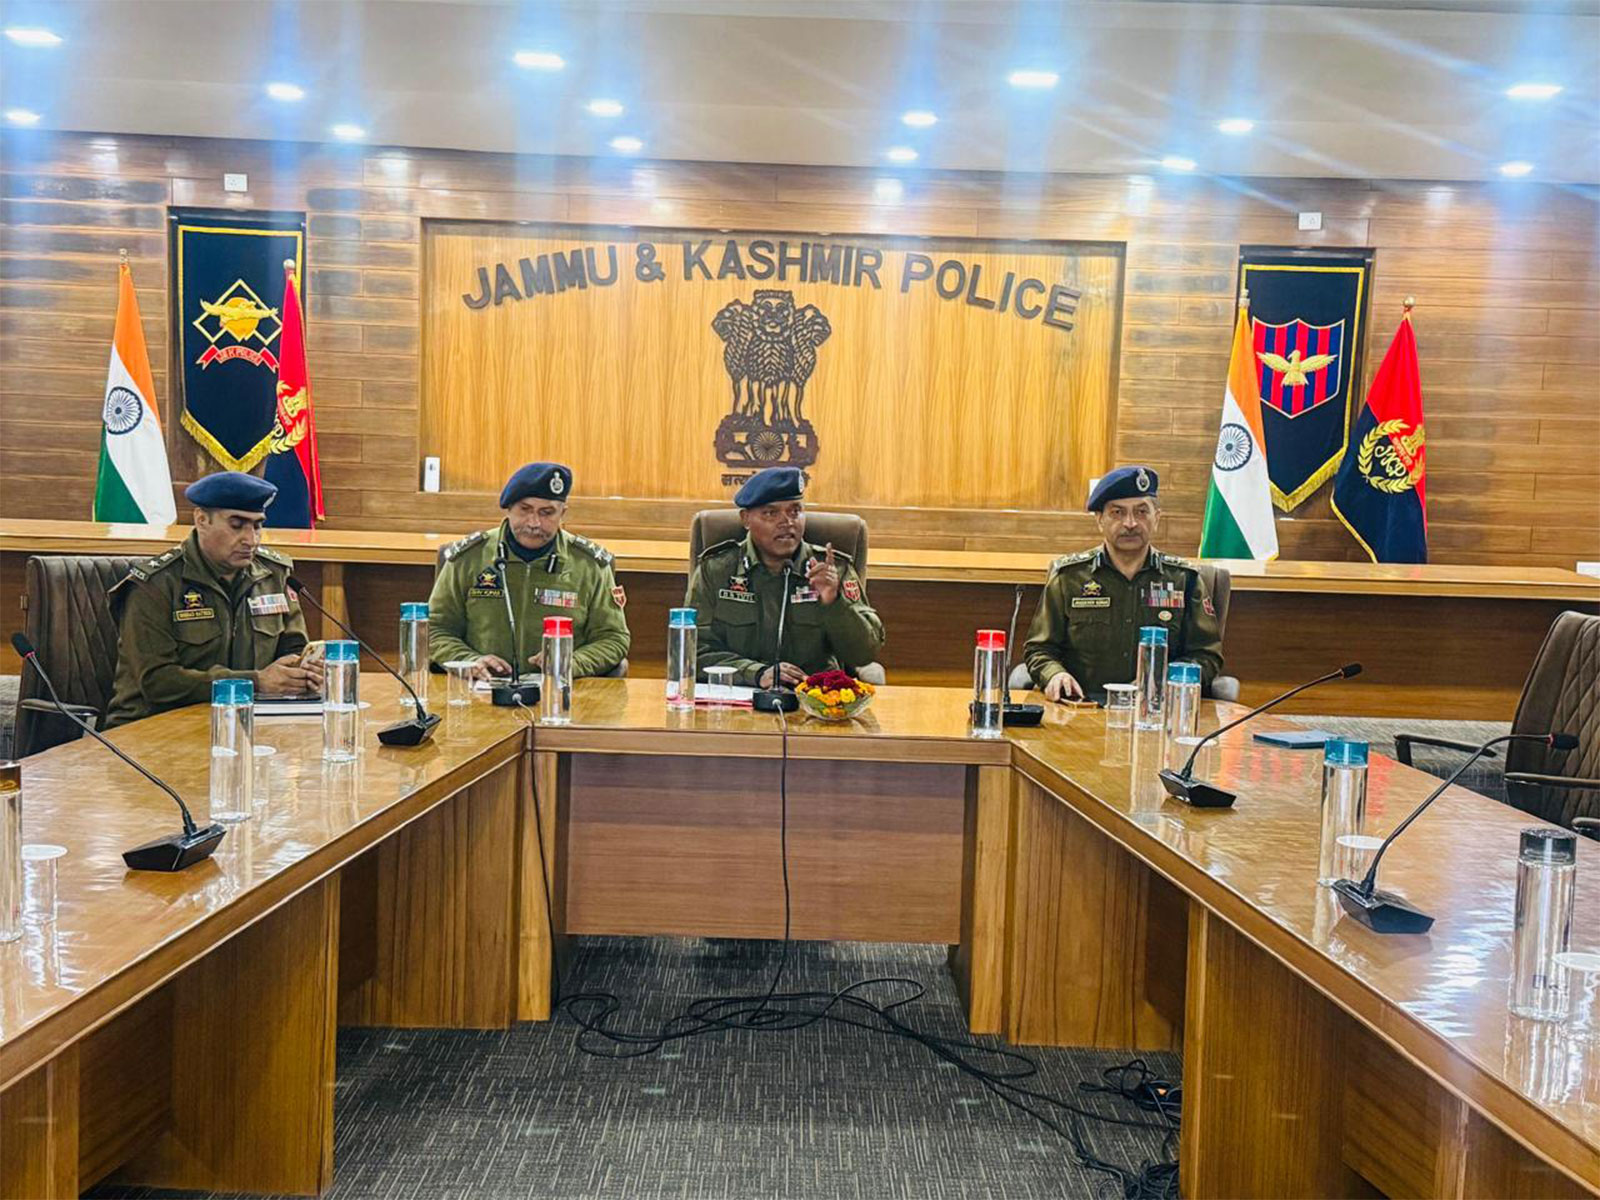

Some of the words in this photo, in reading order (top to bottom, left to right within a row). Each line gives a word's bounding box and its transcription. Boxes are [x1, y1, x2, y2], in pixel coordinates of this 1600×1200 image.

[462, 245, 618, 310] JAMMU
[636, 243, 666, 282] &
[683, 239, 883, 290] KASHMIR
[900, 253, 1081, 332] POLICE
